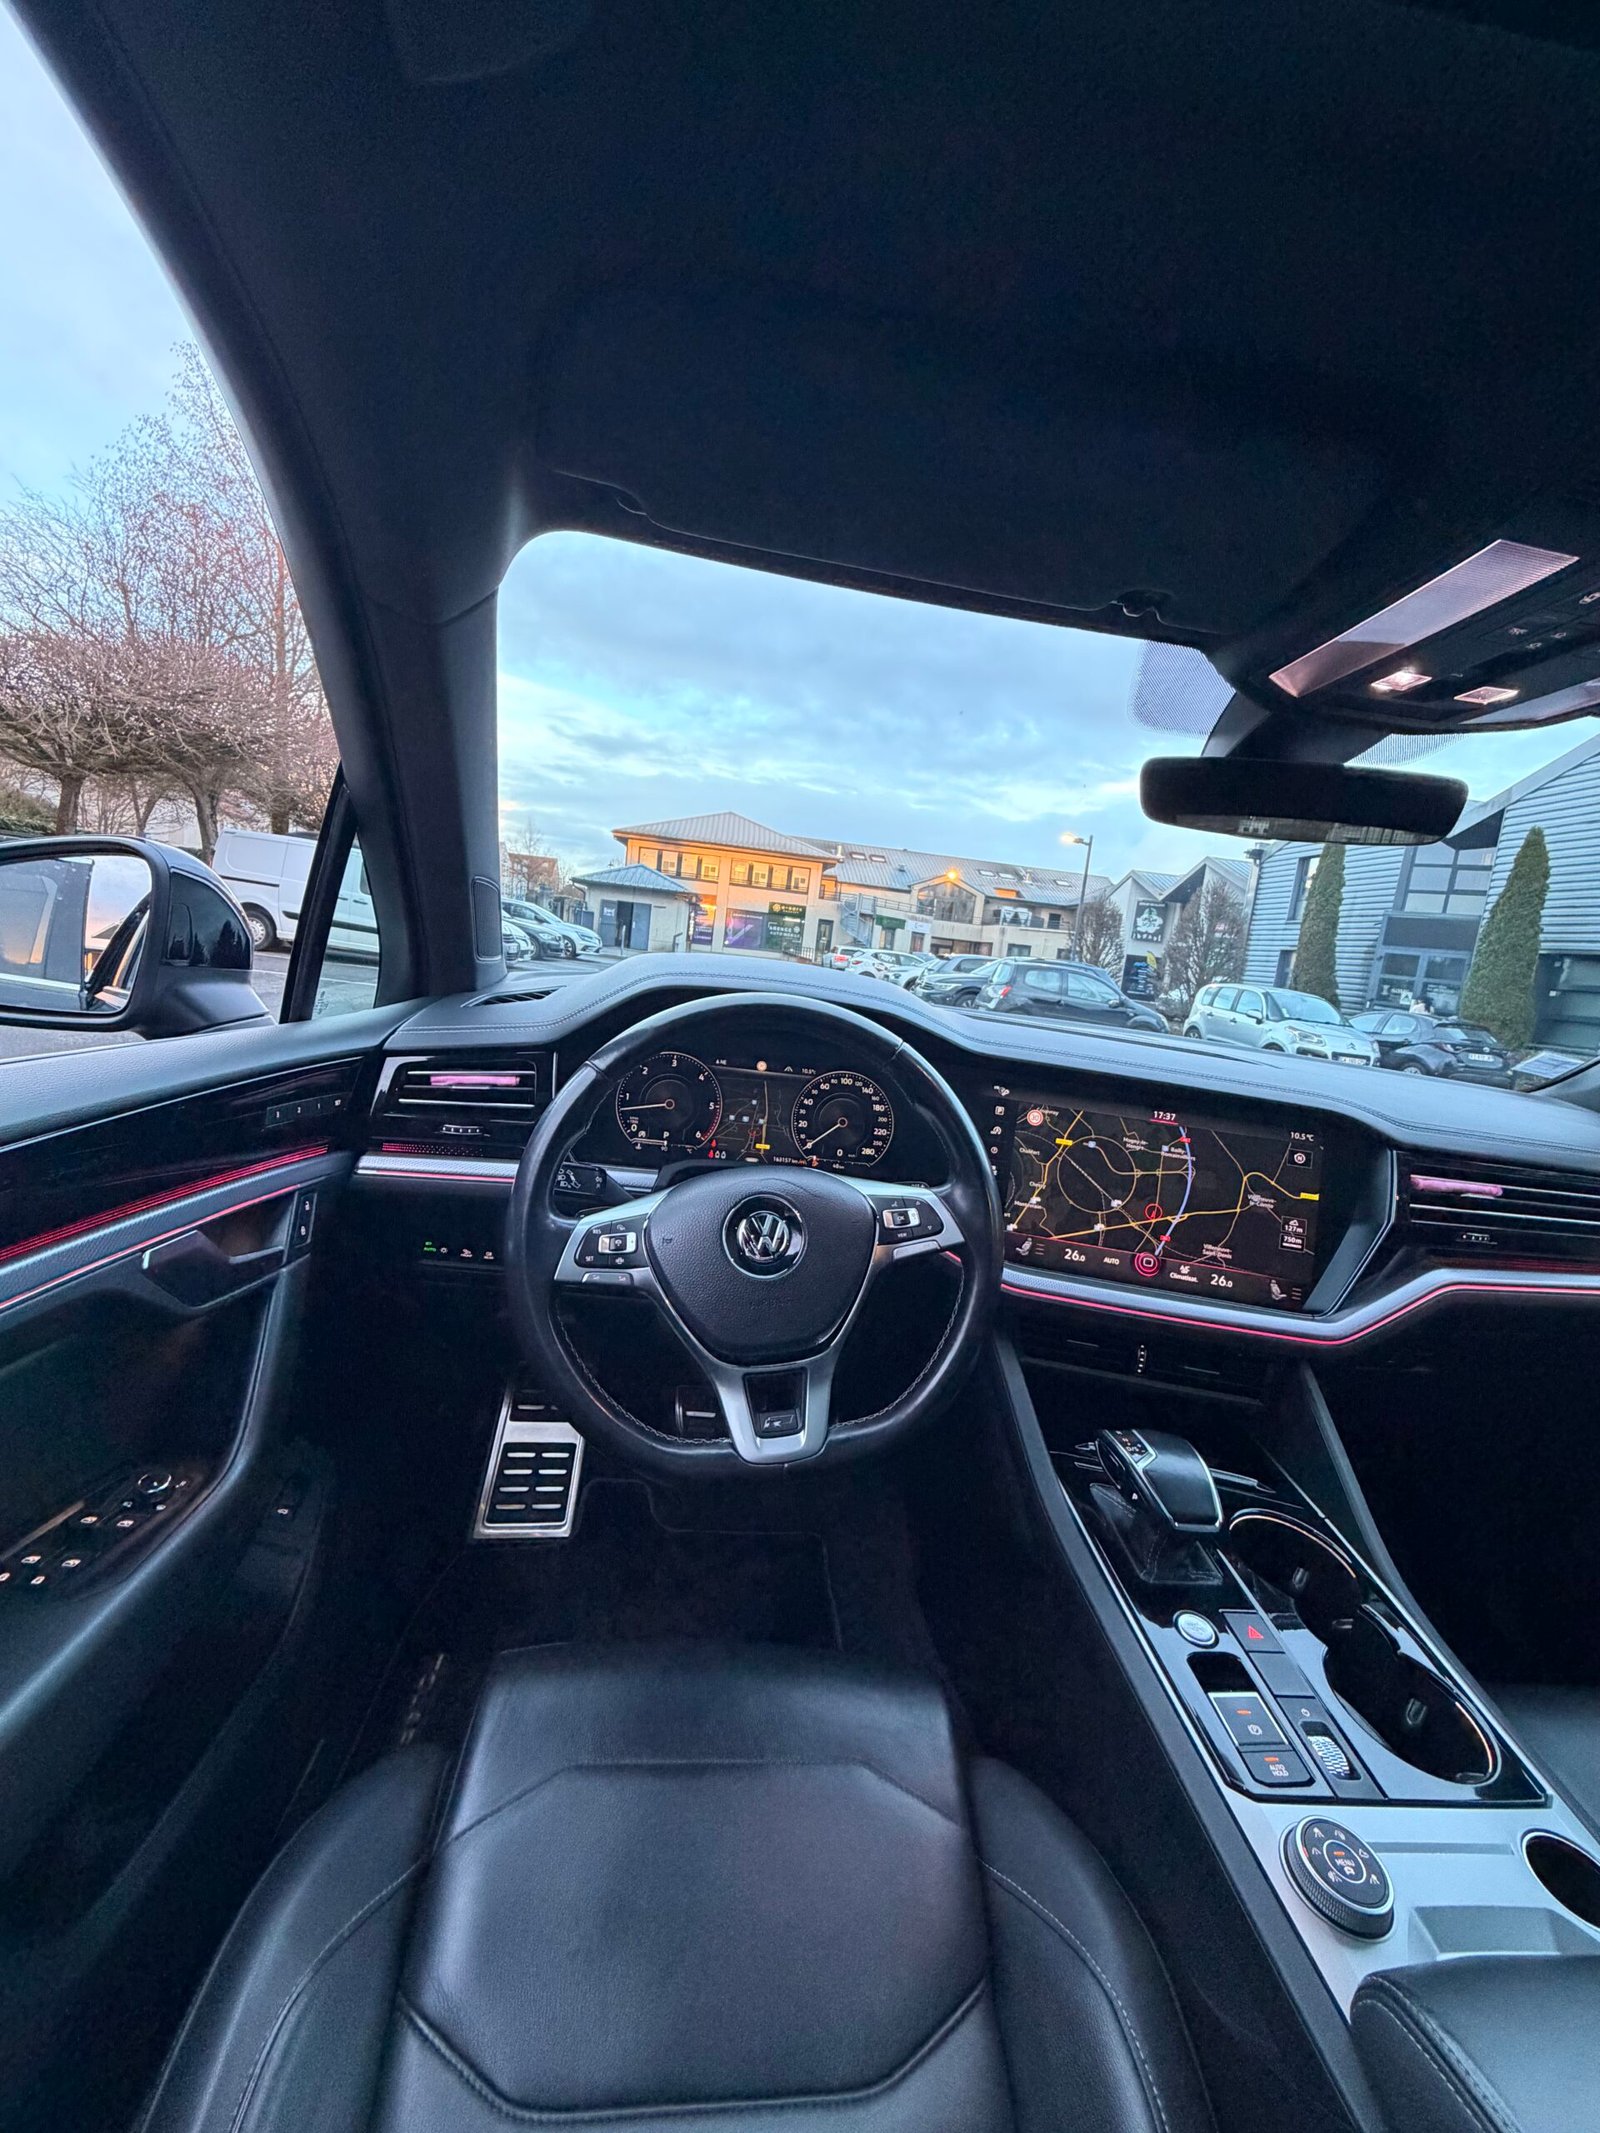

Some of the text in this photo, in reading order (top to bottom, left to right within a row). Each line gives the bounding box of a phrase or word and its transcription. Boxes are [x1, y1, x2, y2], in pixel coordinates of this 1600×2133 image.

[861, 1086, 874, 1094] 140
[708, 1102, 714, 1110] 5
[872, 1104, 885, 1112] 180
[1153, 1110, 1176, 1120] 17:37
[798, 1120, 808, 1128] 20
[696, 1130, 701, 1138] 6
[861, 1148, 875, 1156] 280
[1064, 1248, 1086, 1262] 26.0
[1103, 1256, 1120, 1266] AUTO
[1210, 1274, 1233, 1288] 26.0
[1269, 1764, 1286, 1772] AUTO
[1272, 1769, 1289, 1777] HOLD
[1334, 1858, 1356, 1868] MENU
